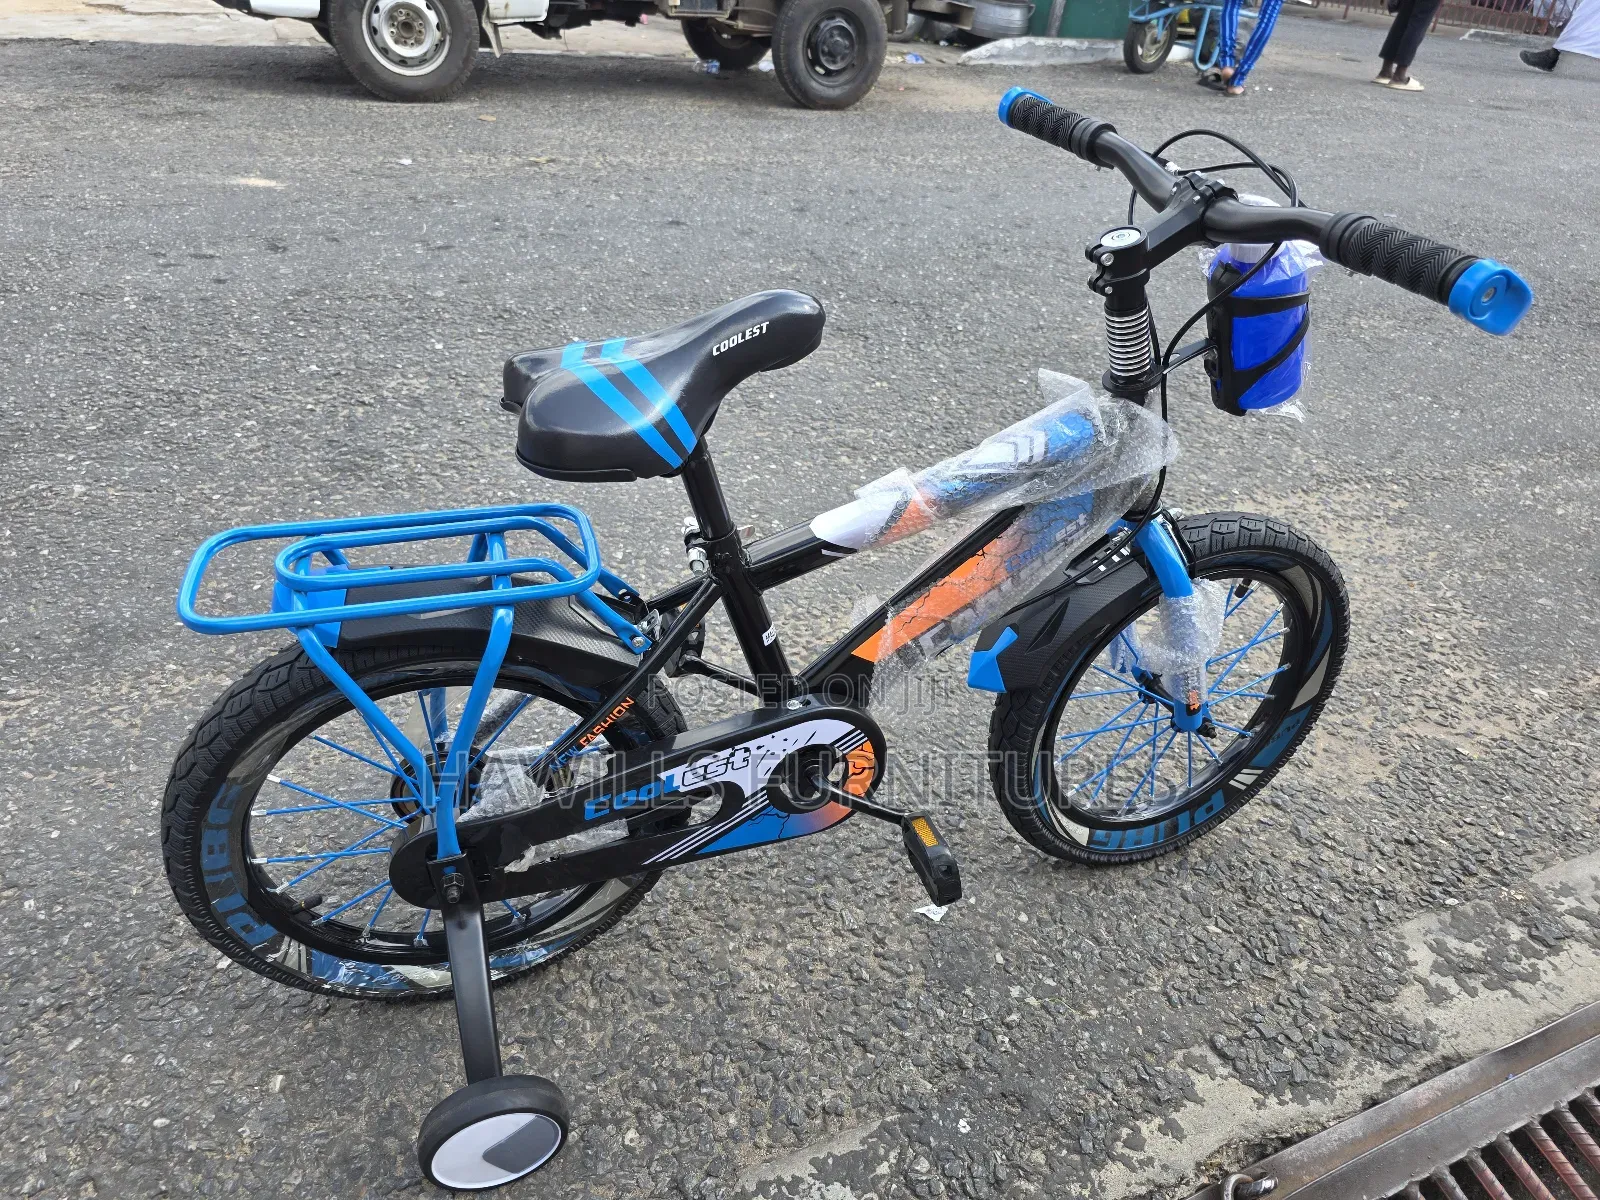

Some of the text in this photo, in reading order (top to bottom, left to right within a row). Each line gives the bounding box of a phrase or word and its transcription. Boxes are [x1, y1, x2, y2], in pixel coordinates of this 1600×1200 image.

[712, 321, 770, 357] COOLEST
[1004, 512, 1088, 574] Cest
[548, 696, 636, 772] NEW FASHION
